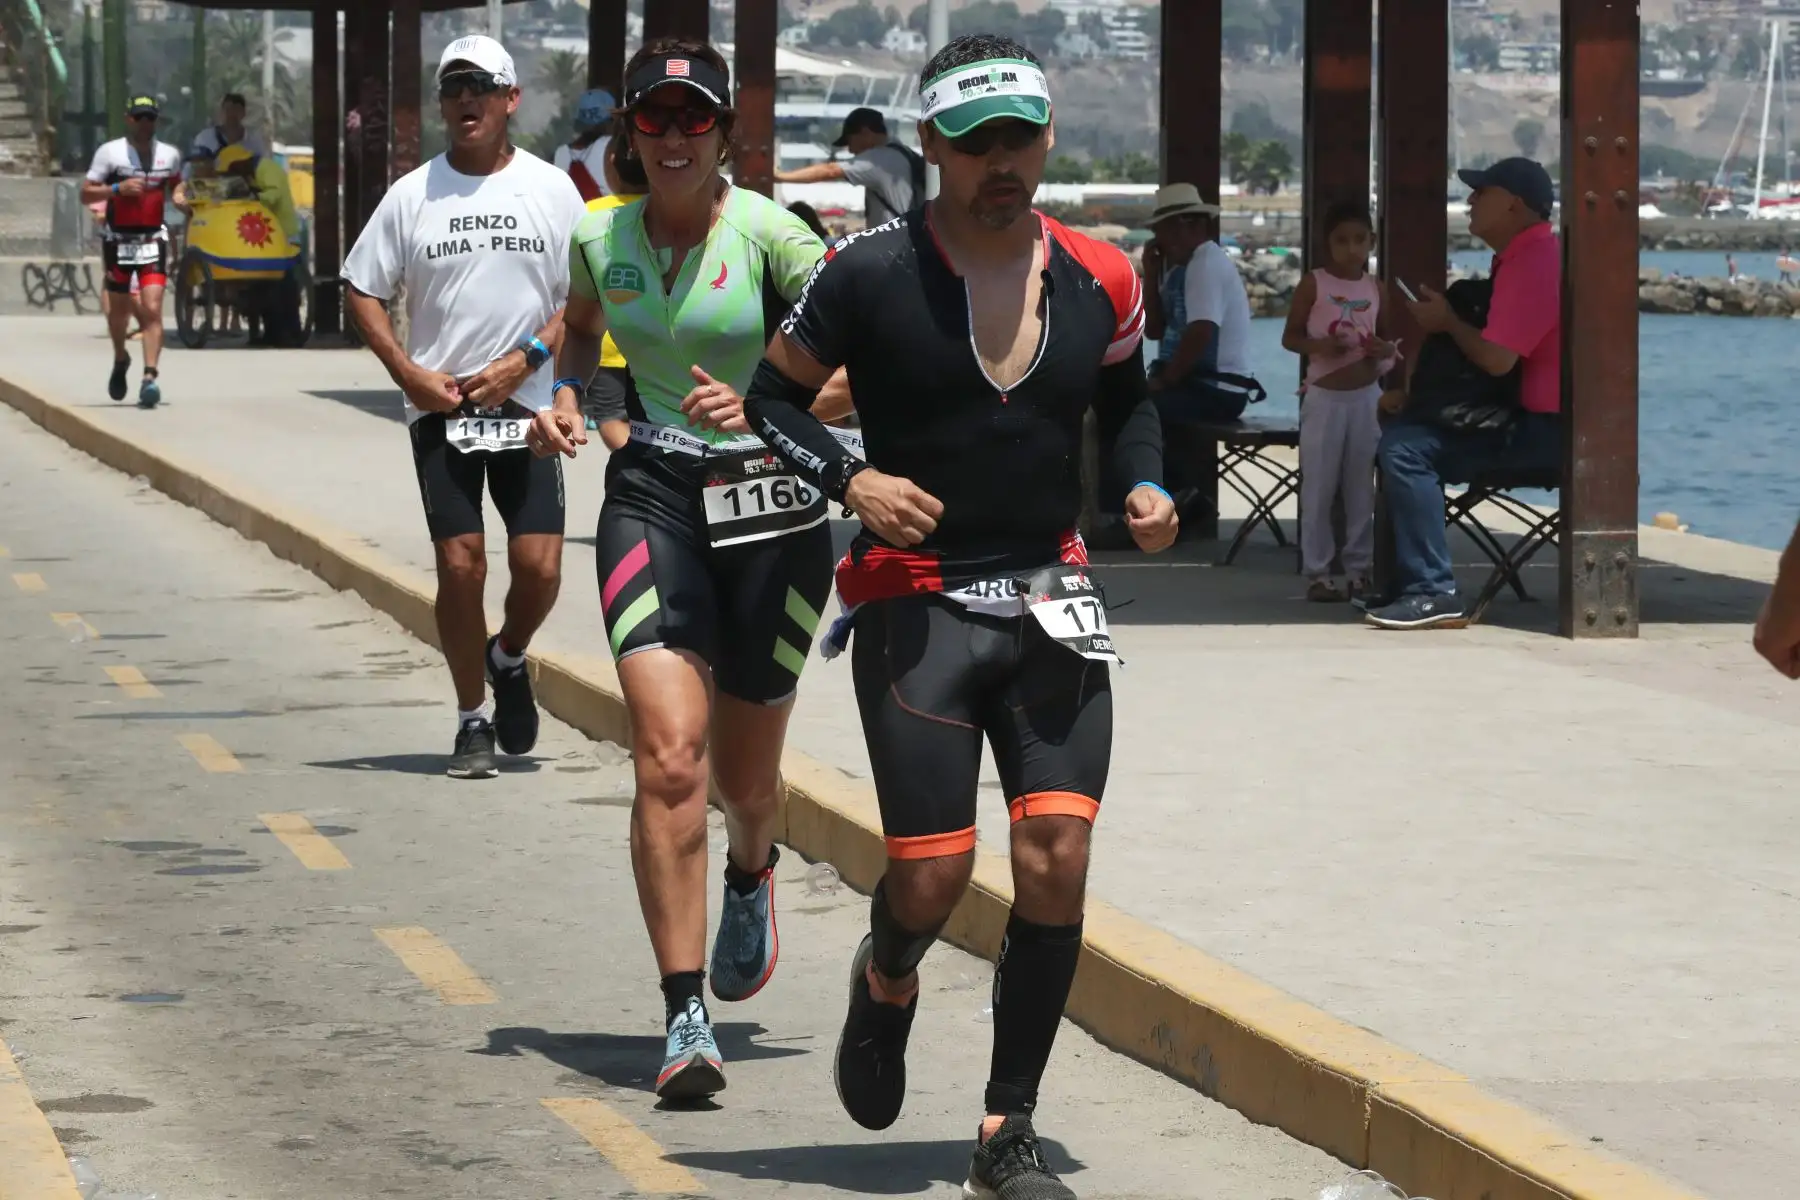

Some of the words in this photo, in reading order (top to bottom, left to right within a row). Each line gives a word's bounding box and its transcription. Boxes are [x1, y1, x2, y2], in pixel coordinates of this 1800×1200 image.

[960, 86, 984, 100] 70.3
[449, 214, 517, 233] RENZO
[426, 238, 473, 260] LIMA
[491, 234, 545, 254] PERÚ
[609, 267, 639, 288] BR
[458, 420, 521, 439] 1118
[650, 429, 687, 446] FLETS
[762, 415, 828, 474] TREK
[745, 465, 760, 475] 70.3
[722, 479, 812, 517] 1166
